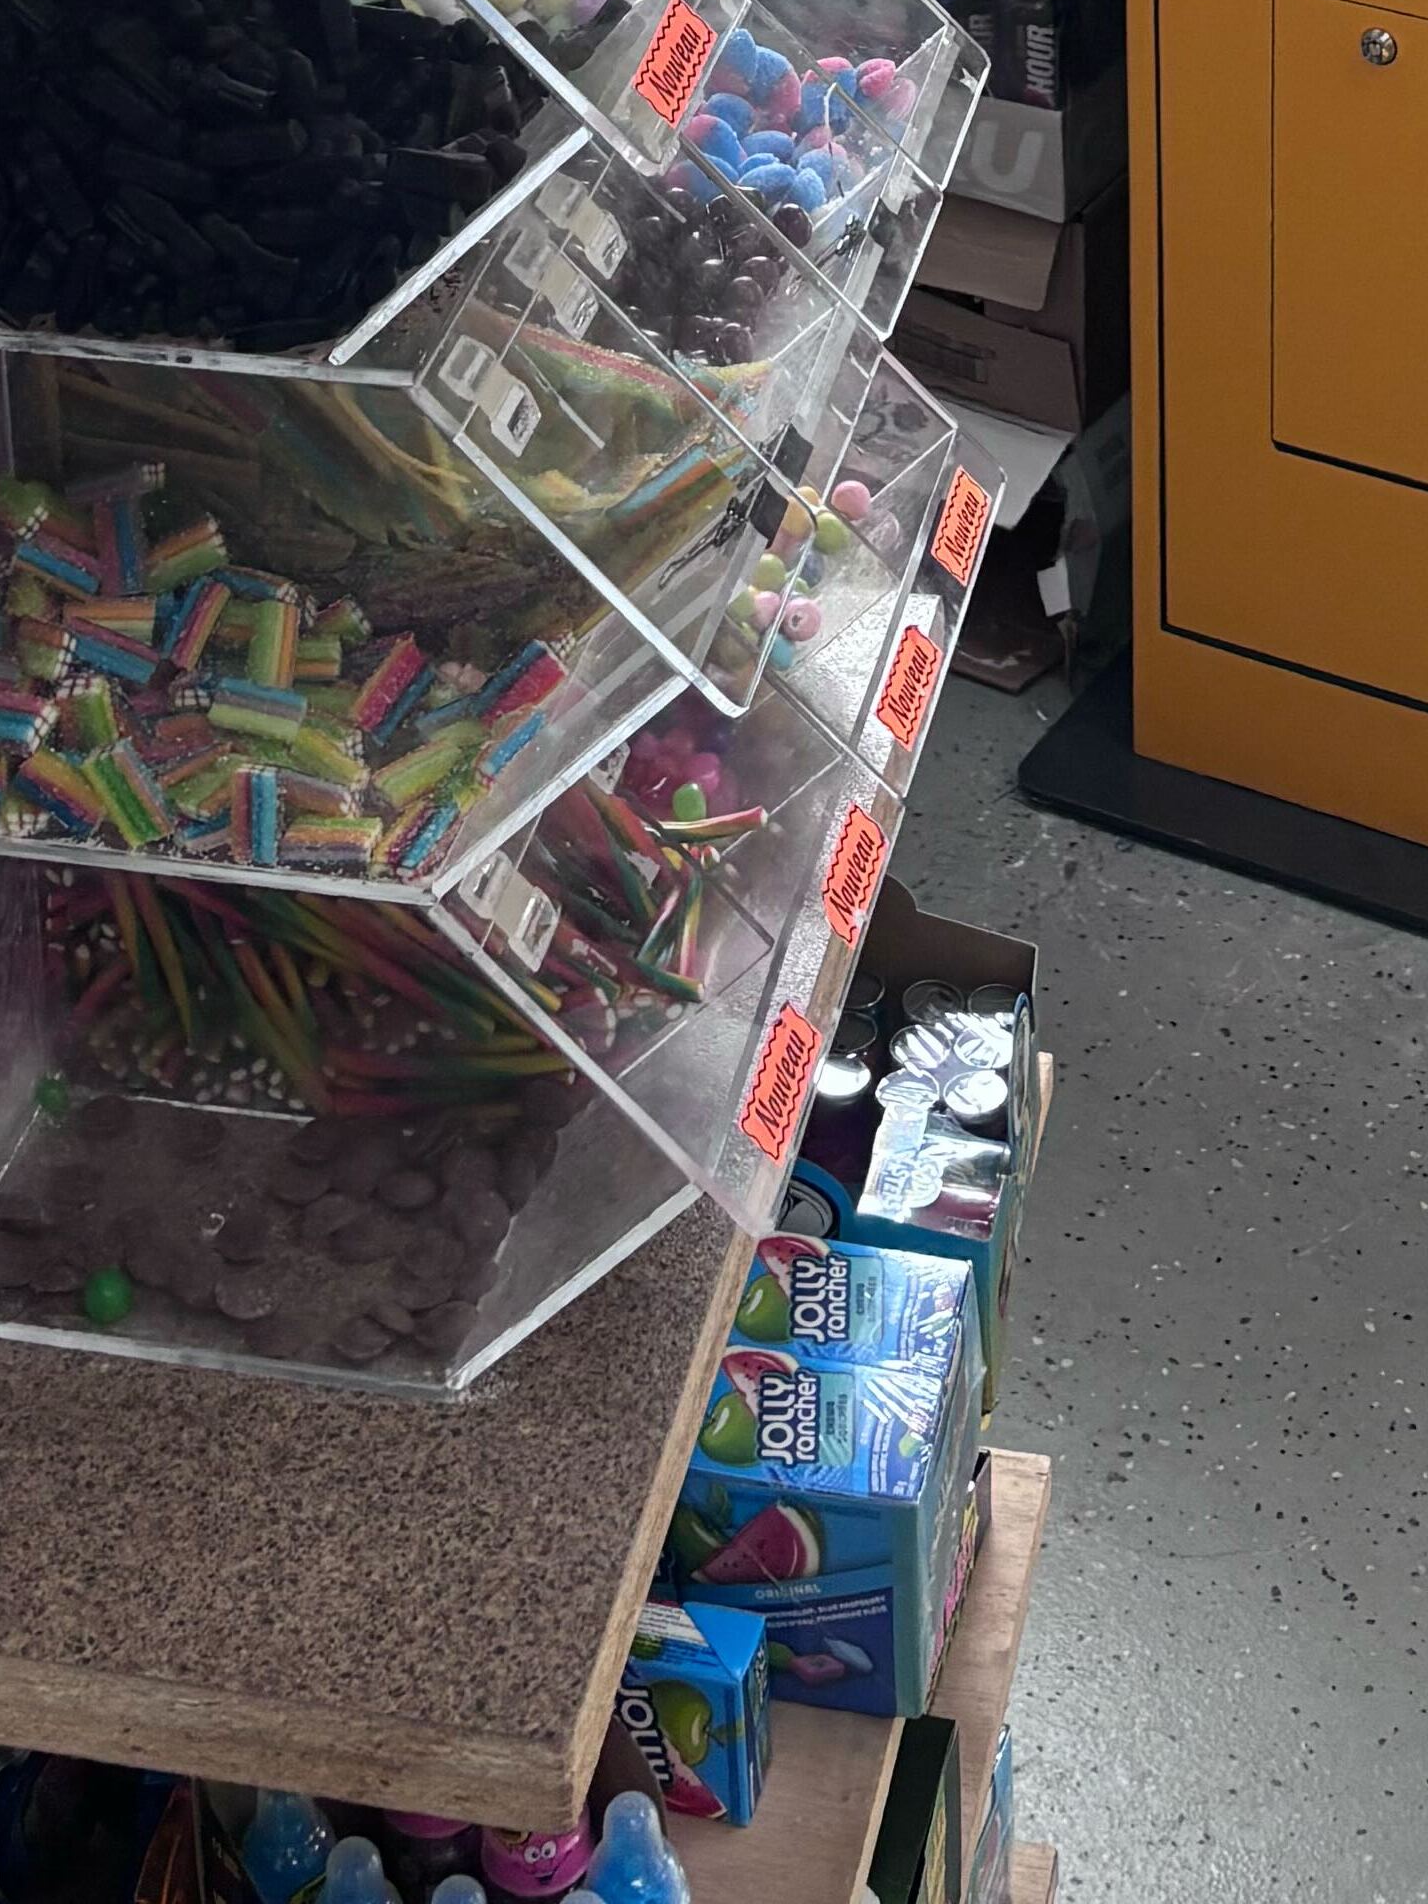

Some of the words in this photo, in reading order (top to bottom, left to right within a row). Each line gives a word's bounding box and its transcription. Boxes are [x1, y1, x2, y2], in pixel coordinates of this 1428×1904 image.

[646, 12, 701, 109] Nouveau
[792, 1259, 828, 1343] JOLLY
[825, 1257, 848, 1339] rancher
[760, 1376, 795, 1465] JOLLY
